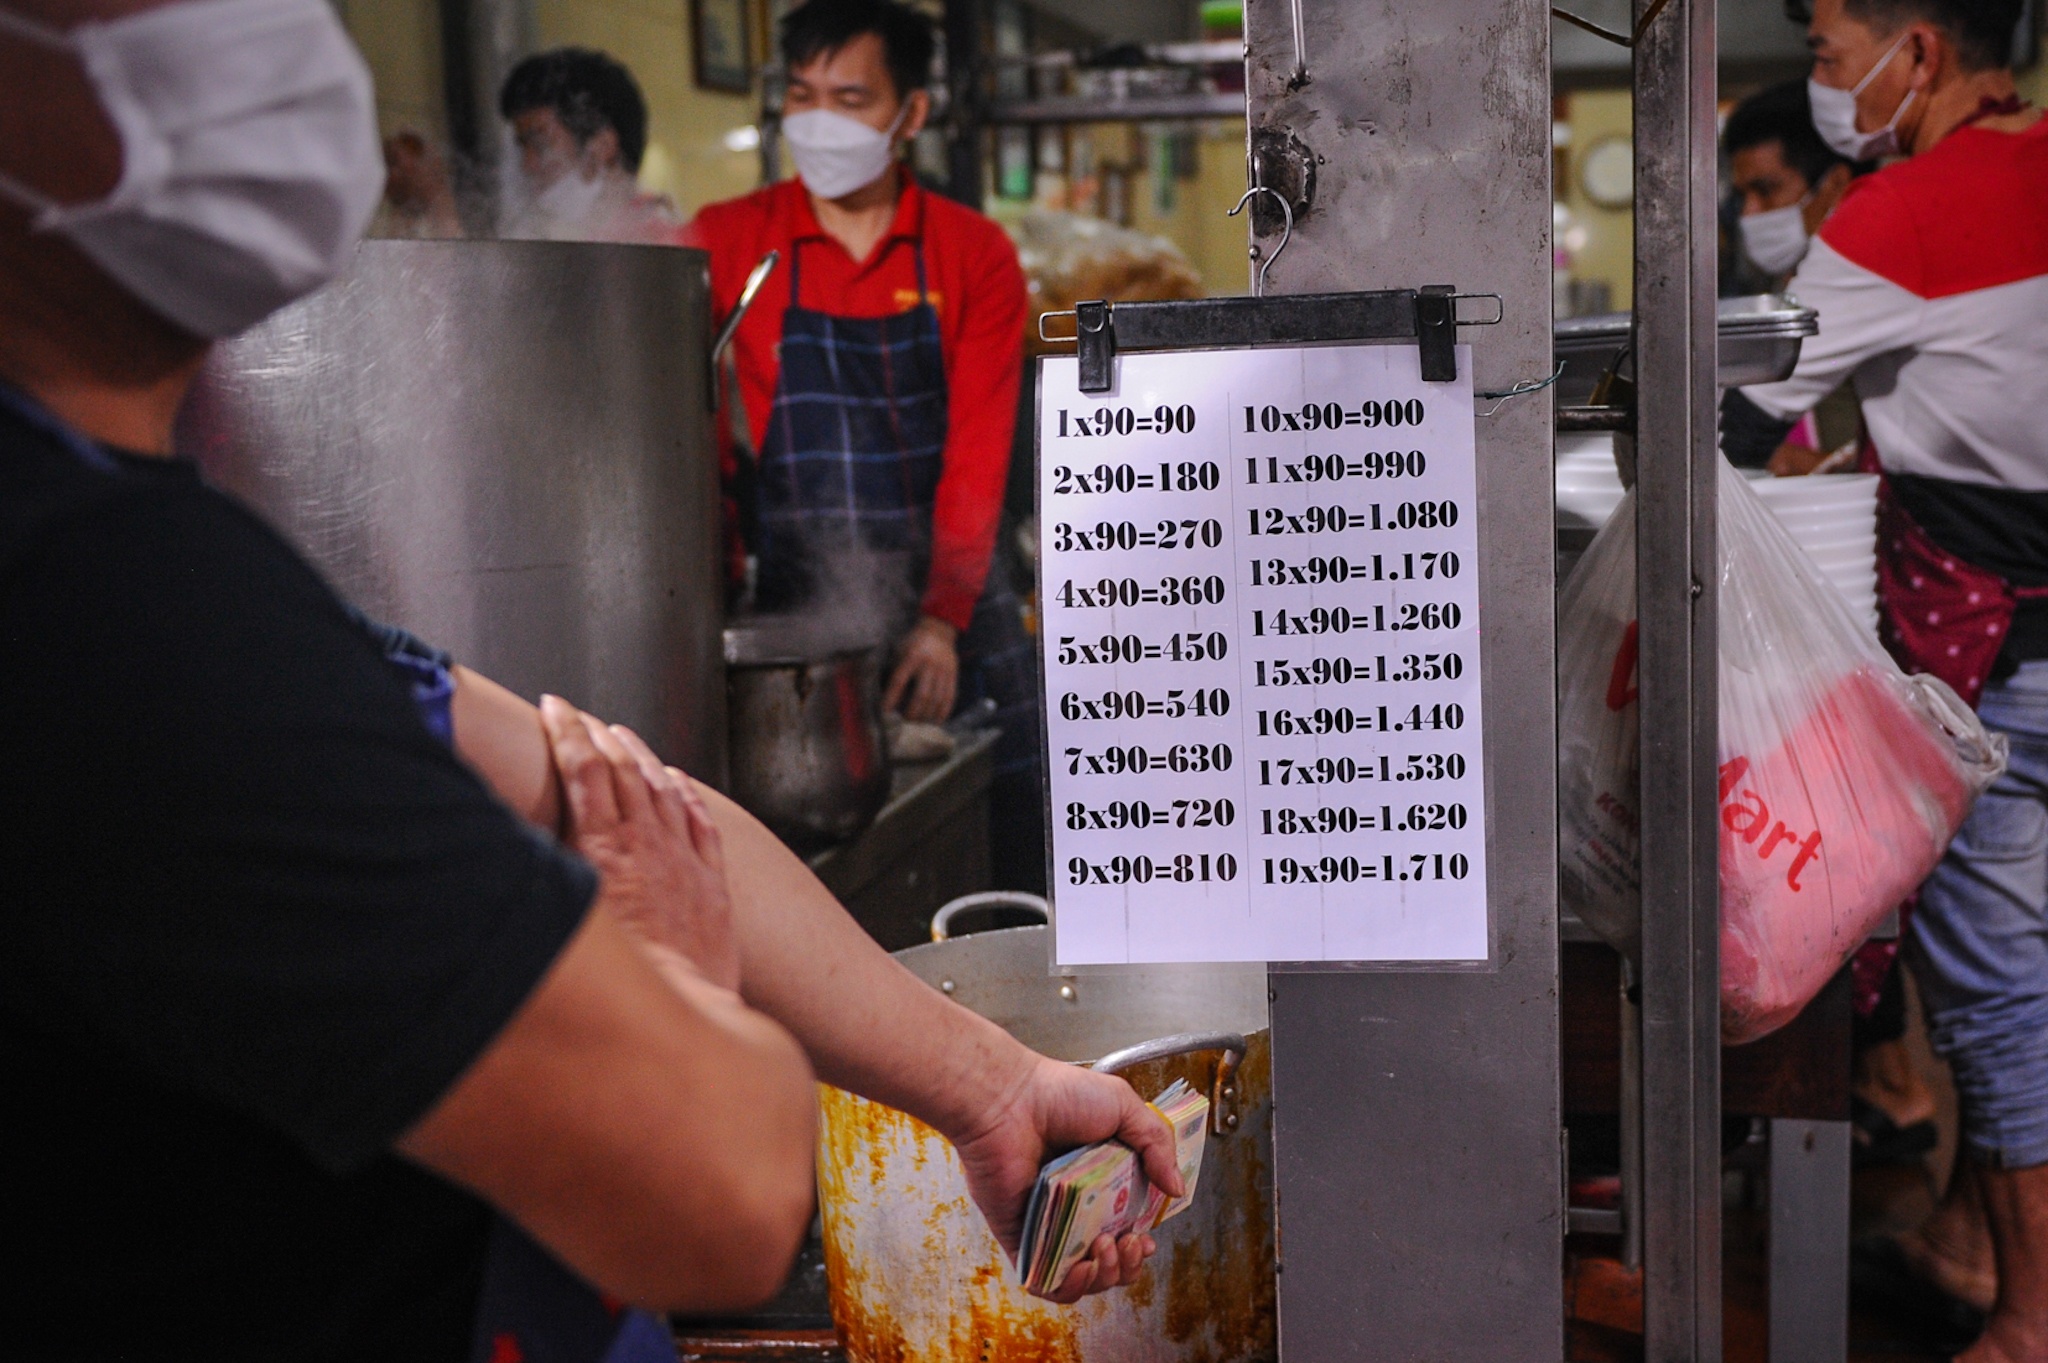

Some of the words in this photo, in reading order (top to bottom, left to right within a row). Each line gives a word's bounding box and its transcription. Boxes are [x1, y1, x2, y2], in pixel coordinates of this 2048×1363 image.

[1057, 404, 1196, 437] 1x90=90
[1244, 398, 1425, 433] 10x90=900
[1053, 461, 1220, 495] 2x90=180
[1245, 450, 1426, 485] 11x90=990
[1248, 499, 1459, 536] 12x90=1.080
[1054, 518, 1223, 552] 3x90=270
[1250, 551, 1460, 586] 13x90=1.170
[1055, 575, 1225, 608] 4x90=360
[1252, 602, 1462, 637] 14x90=1.260
[1058, 631, 1228, 665] 5x90=450
[1254, 652, 1463, 687] 15x90=1.350
[1060, 687, 1230, 721] 6x90=540
[1256, 703, 1464, 737] 16x90=1.440
[1064, 743, 1233, 776] 7x90=630
[1259, 753, 1466, 786] 17x90=1.530
[1066, 798, 1235, 831] 8x90=720
[1260, 803, 1468, 835] 18x90=1.620
[1068, 852, 1238, 886] 9x90=810
[1263, 853, 1469, 885] 19x90=1.710
